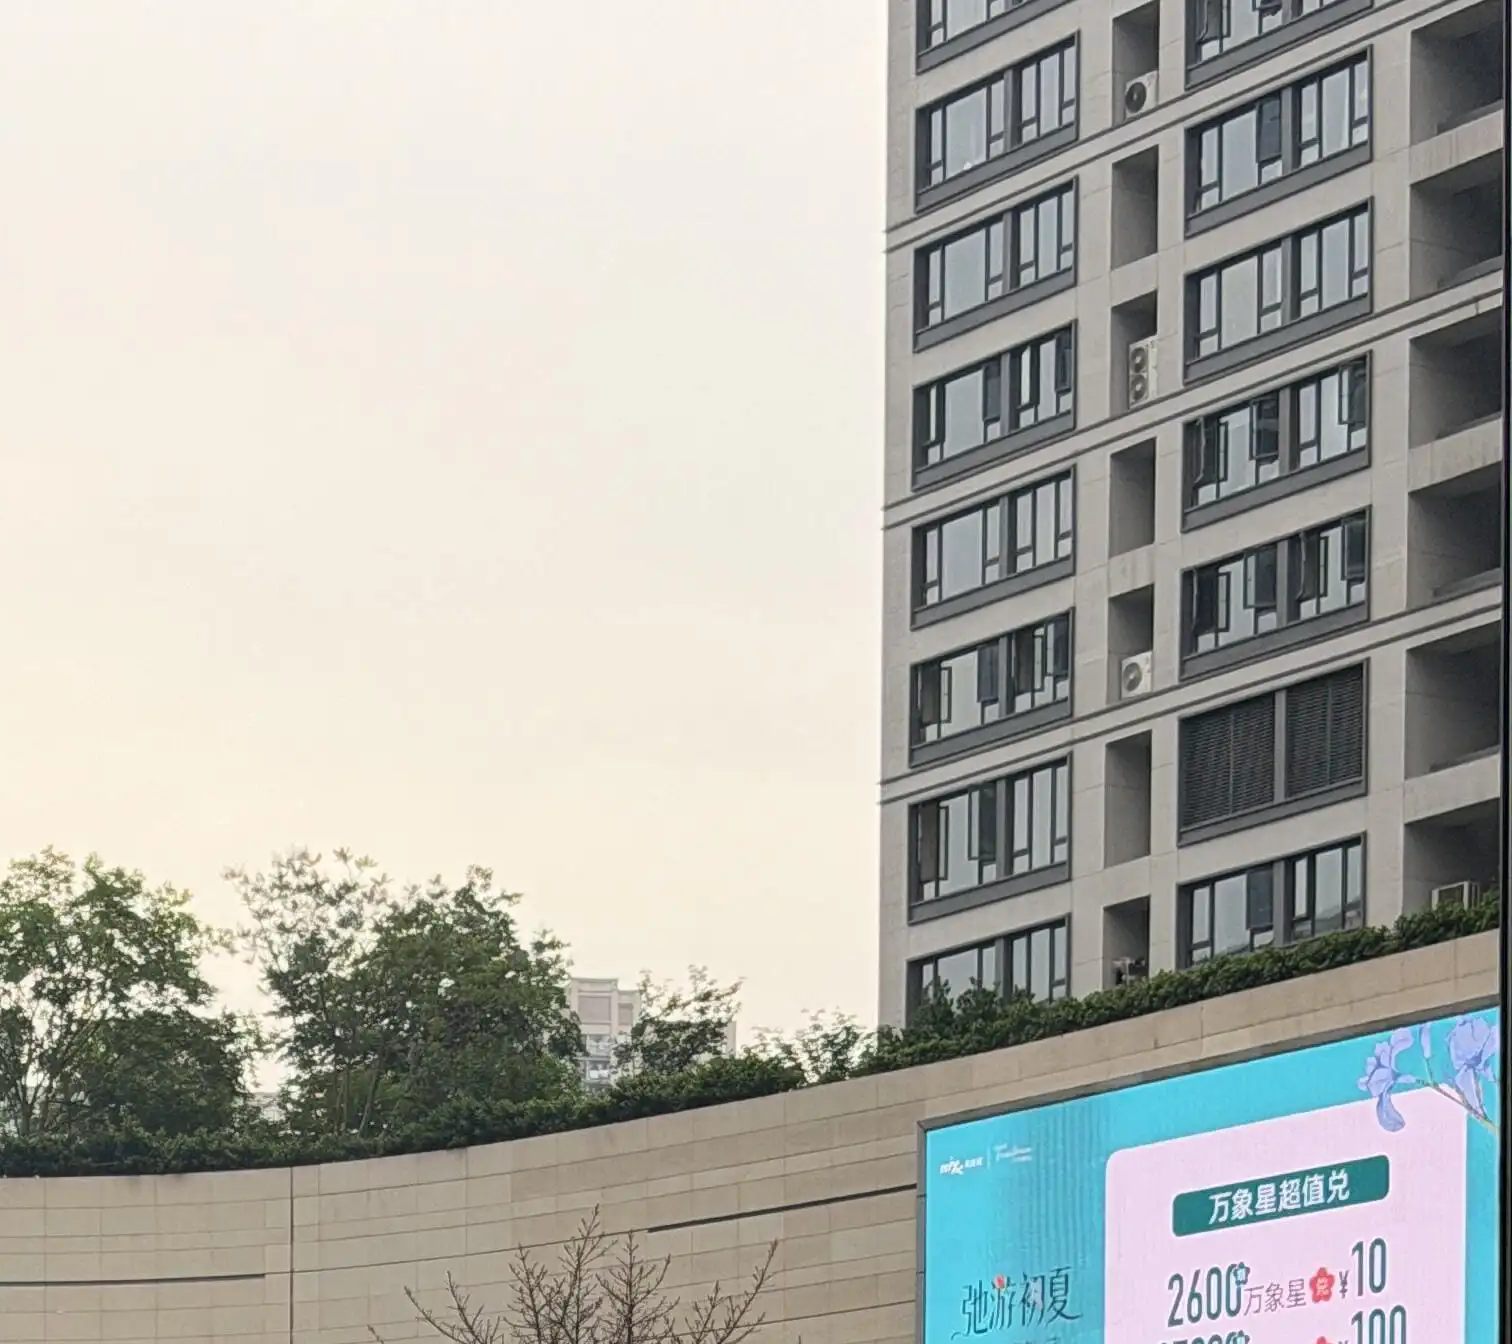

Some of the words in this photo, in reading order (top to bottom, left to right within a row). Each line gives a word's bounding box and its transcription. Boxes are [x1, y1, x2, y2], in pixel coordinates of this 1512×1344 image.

[1208, 1168, 1350, 1225] 万象星超值兑
[1167, 1263, 1242, 1328] 2600
[1243, 1278, 1308, 1316] 万象星
